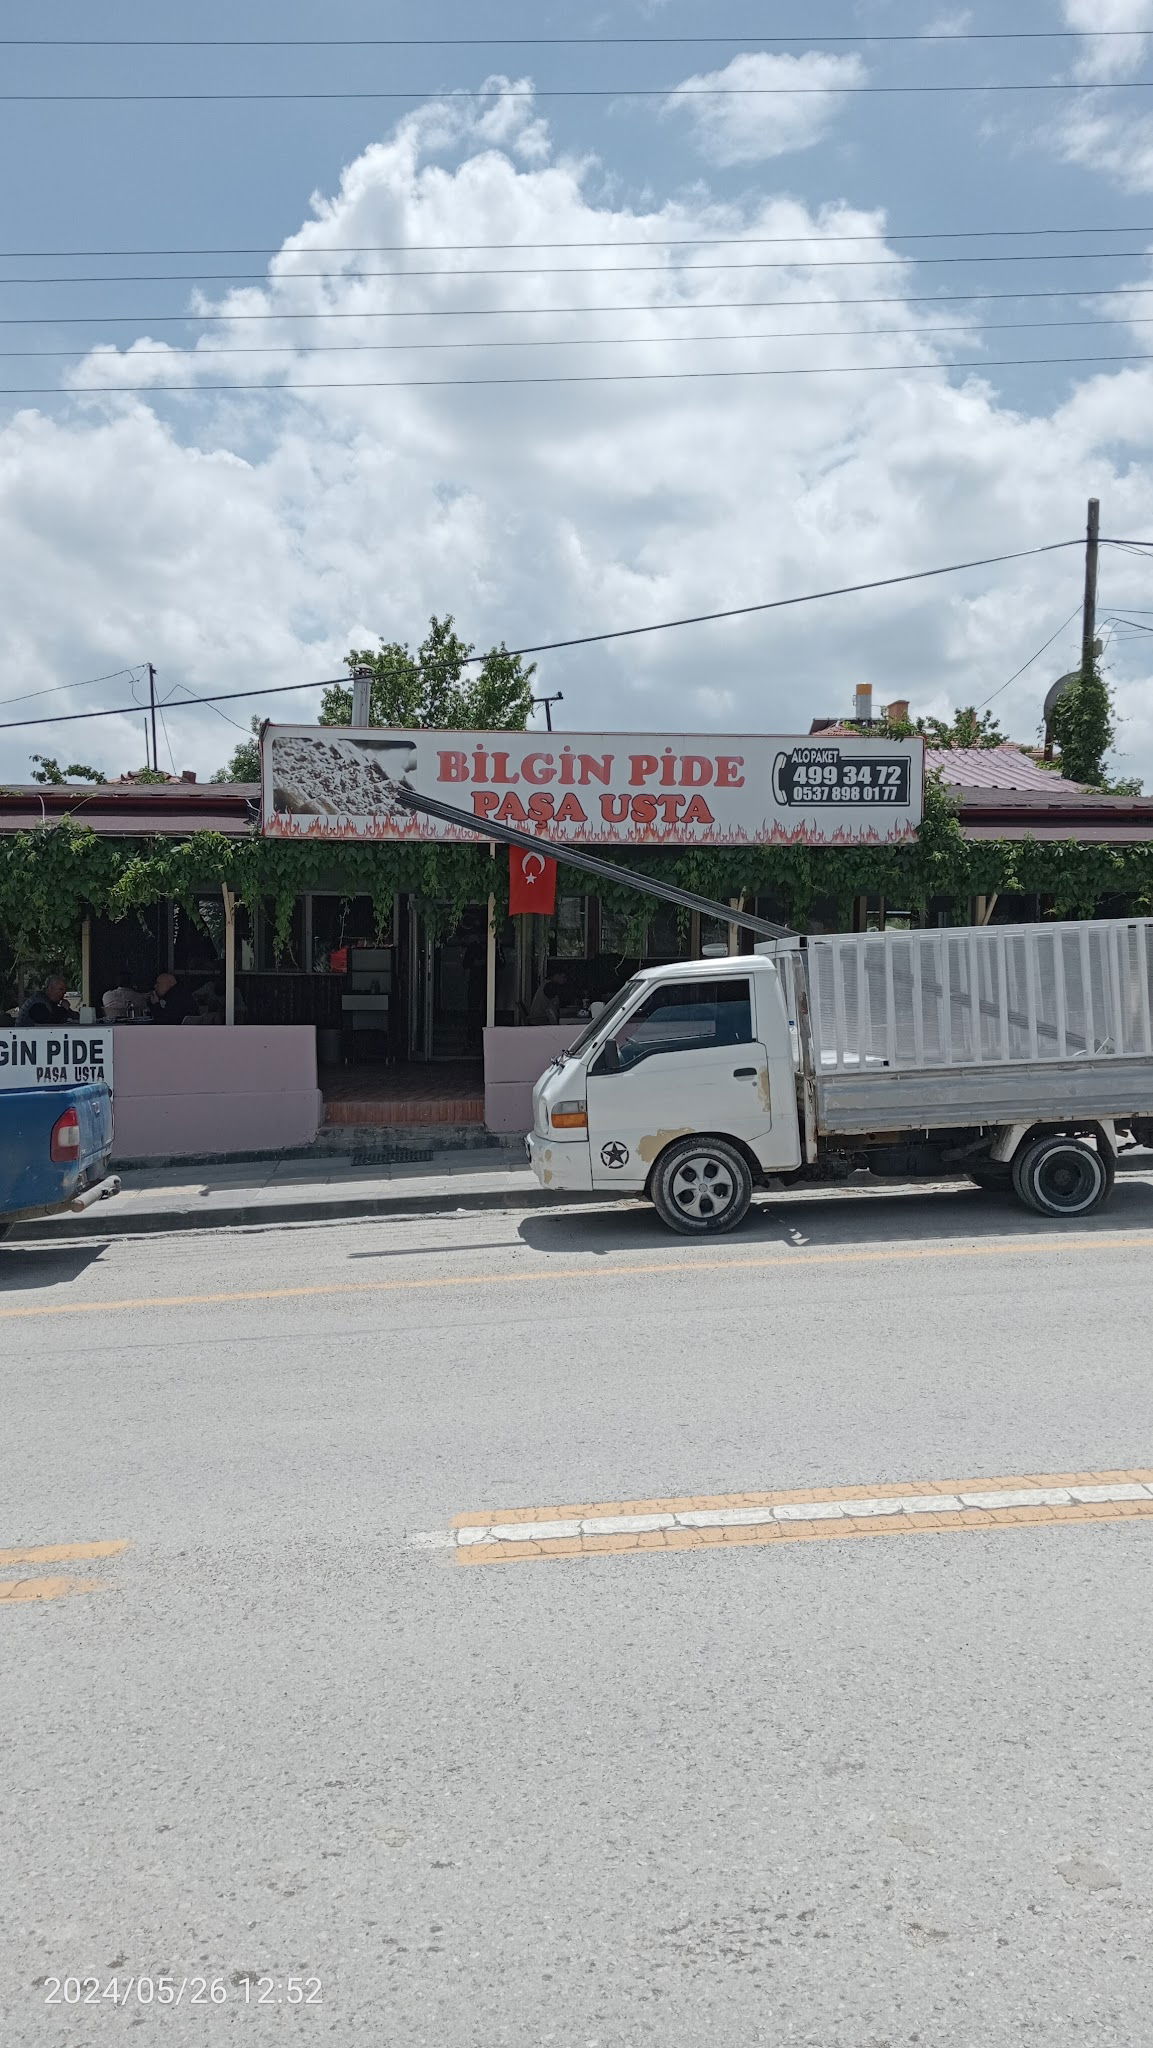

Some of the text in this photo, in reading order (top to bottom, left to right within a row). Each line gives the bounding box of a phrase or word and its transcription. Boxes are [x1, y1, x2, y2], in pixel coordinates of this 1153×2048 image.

[437, 744, 745, 787] BİLGİN PİDE
[793, 766, 901, 785] 499 34 72
[793, 787, 829, 801] 0537
[831, 787, 860, 801] 898
[471, 791, 715, 829] PAŞA USTA
[47, 1034, 104, 1065] PİDE
[74, 1066, 105, 1082] USTA
